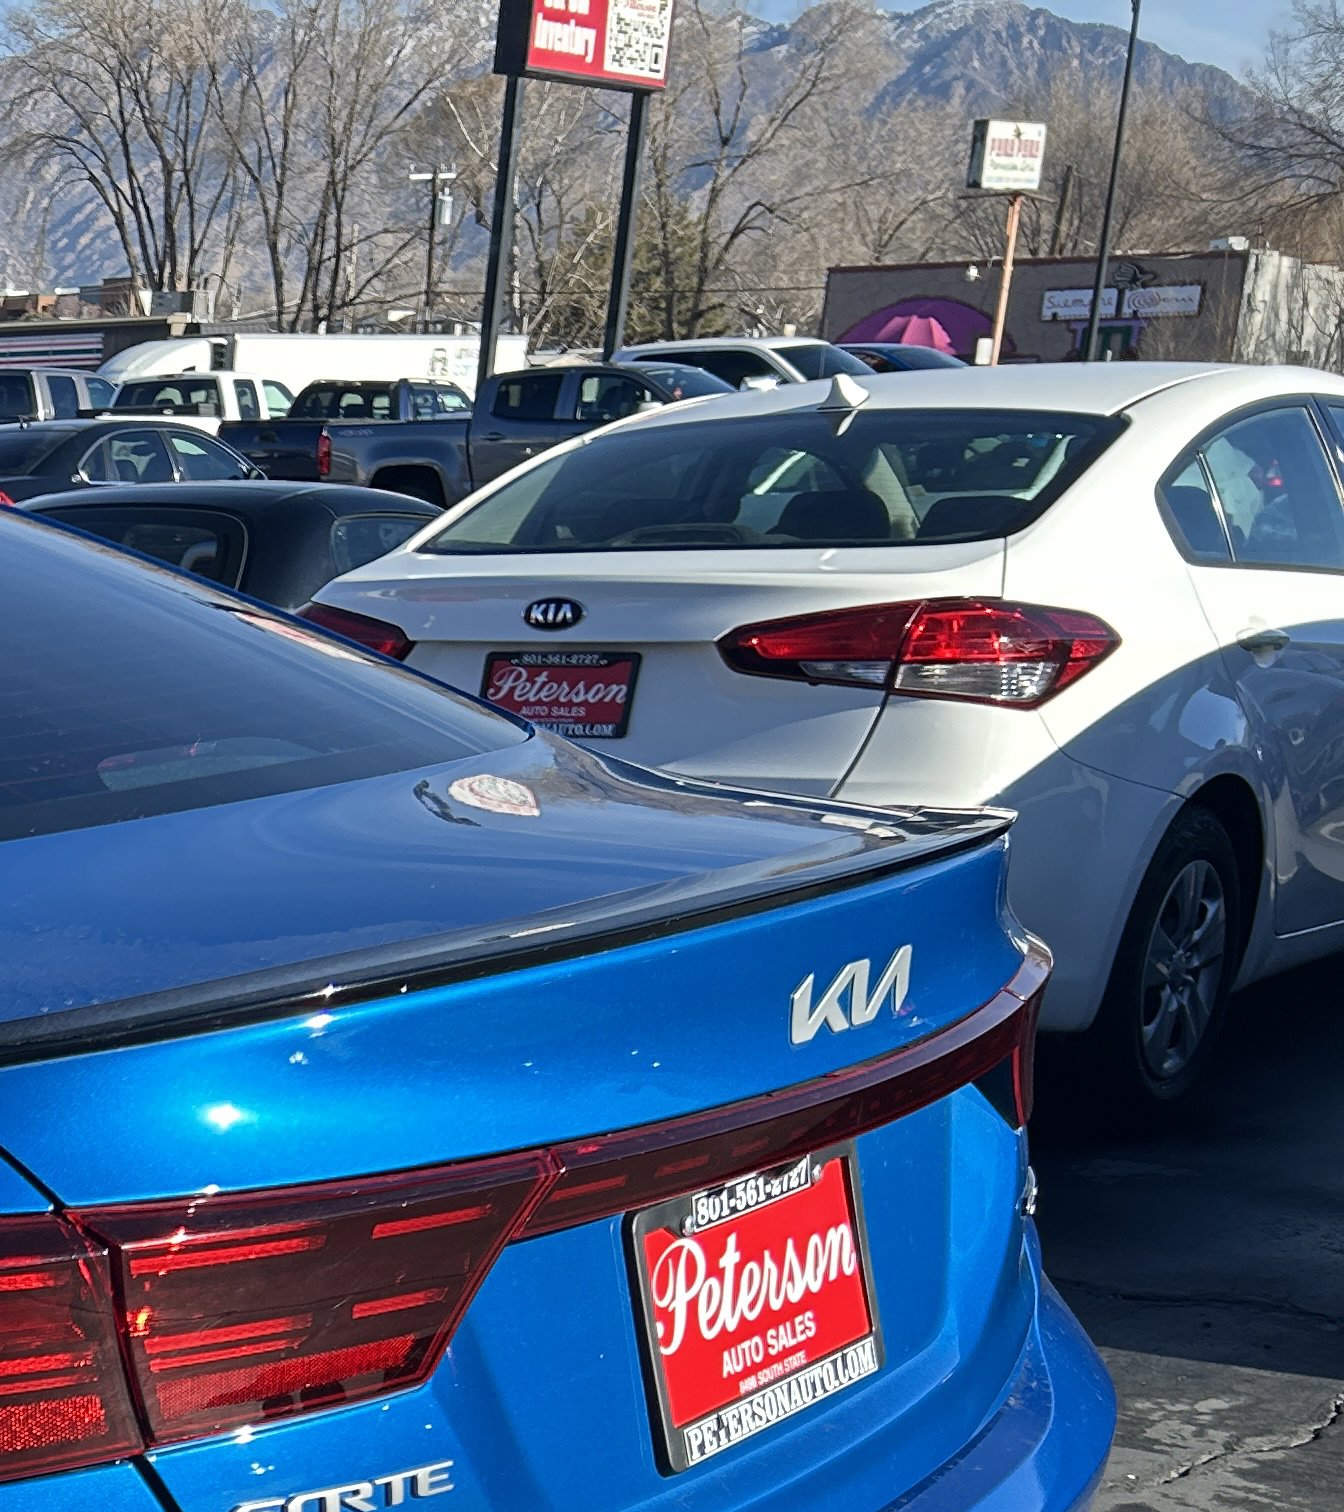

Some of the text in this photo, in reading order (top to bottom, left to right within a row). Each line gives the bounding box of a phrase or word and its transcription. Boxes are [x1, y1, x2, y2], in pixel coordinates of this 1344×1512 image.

[529, 603, 574, 624] KIA
[487, 666, 628, 704] Peterson
[520, 706, 587, 717] AUTO SALES
[790, 944, 913, 1046] KIA
[653, 1224, 857, 1355] Peterson
[722, 1311, 817, 1378] AUTO SALES
[757, 1362, 784, 1385] SOUTH
[783, 1350, 807, 1372] STATE
